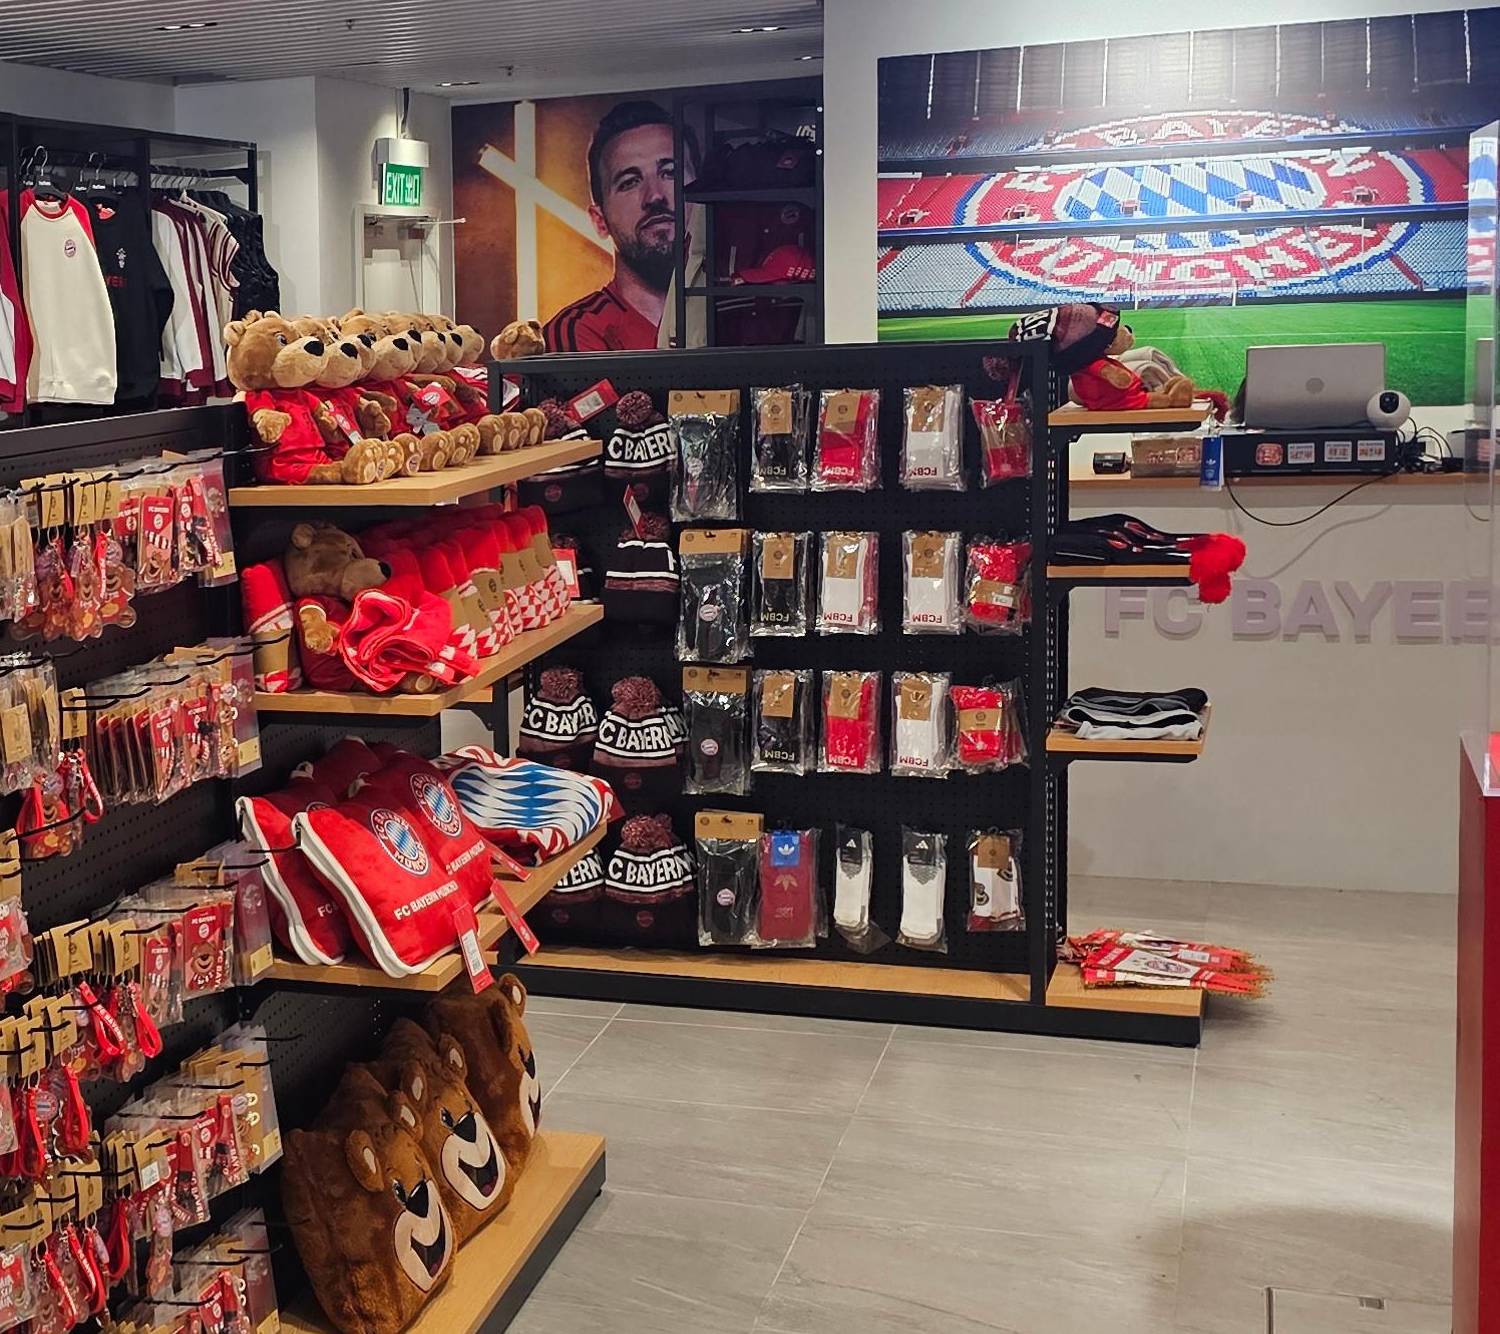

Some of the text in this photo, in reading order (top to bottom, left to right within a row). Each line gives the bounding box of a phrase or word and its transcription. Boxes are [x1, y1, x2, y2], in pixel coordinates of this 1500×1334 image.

[385, 172, 405, 204] EXIT
[909, 466, 938, 477] FCBM
[760, 612, 790, 623] FCBM
[823, 612, 853, 623] FCBM
[912, 613, 942, 624] FCBM
[1104, 586, 1204, 639] FC
[764, 749, 795, 762] FCBM
[828, 753, 858, 766] FCBM
[899, 754, 930, 767] FCBM
[394, 905, 411, 921] FC
